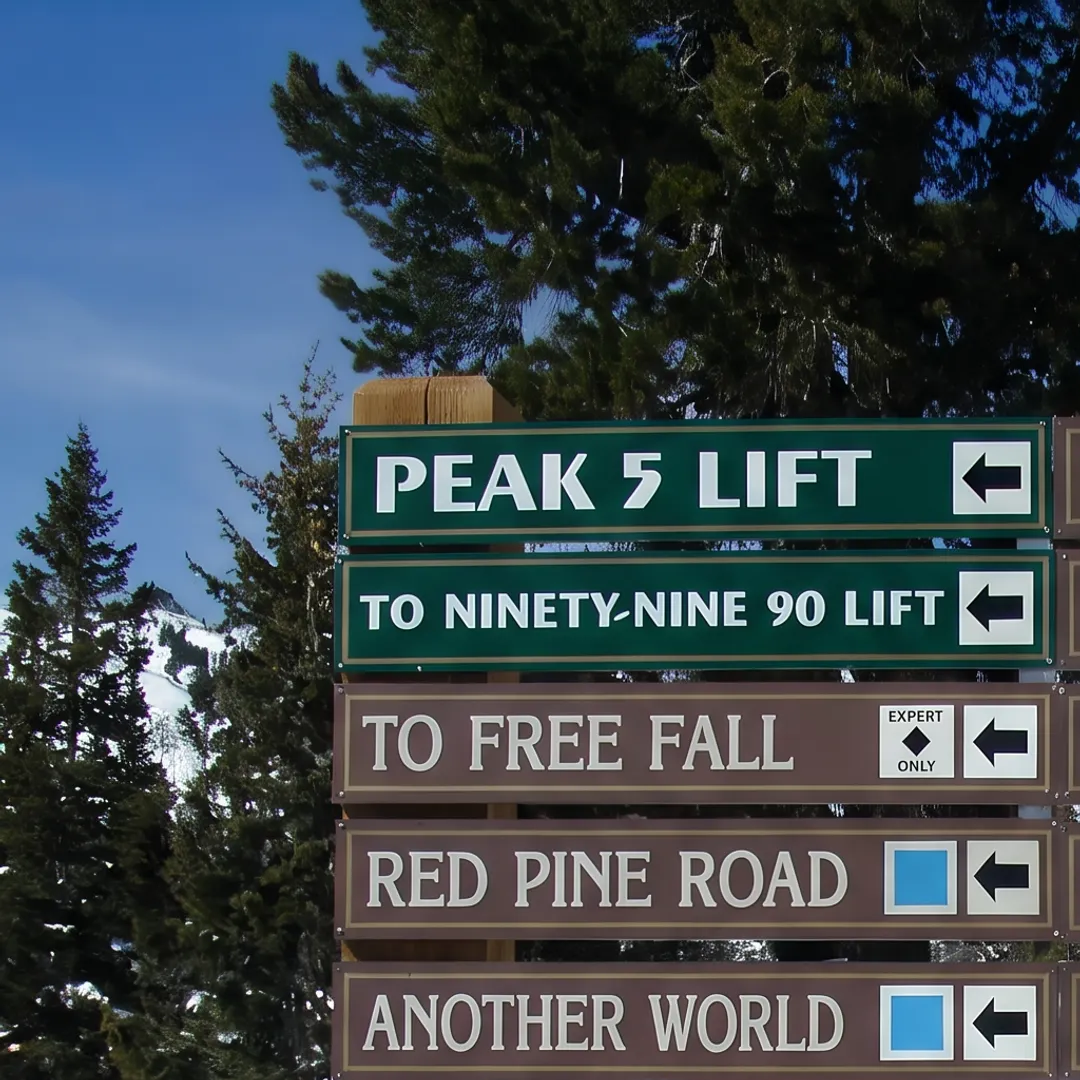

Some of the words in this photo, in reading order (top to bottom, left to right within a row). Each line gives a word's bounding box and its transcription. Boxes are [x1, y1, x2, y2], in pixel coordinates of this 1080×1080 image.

[377, 454, 595, 513] PEAK
[624, 453, 661, 508] 5
[700, 450, 872, 508] LIFT
[360, 594, 424, 630] TO
[767, 590, 825, 626] 90
[845, 591, 944, 625] LIFT
[362, 715, 442, 771] TO
[470, 715, 622, 770] FREE
[650, 715, 793, 770] FALL
[889, 711, 943, 722] EXPERT
[898, 761, 935, 771] ONLY
[367, 852, 487, 907] RED
[515, 851, 651, 907] PINE
[679, 850, 847, 907] ROAD
[363, 994, 626, 1052] ANOTHER
[648, 994, 843, 1053] WORLD
